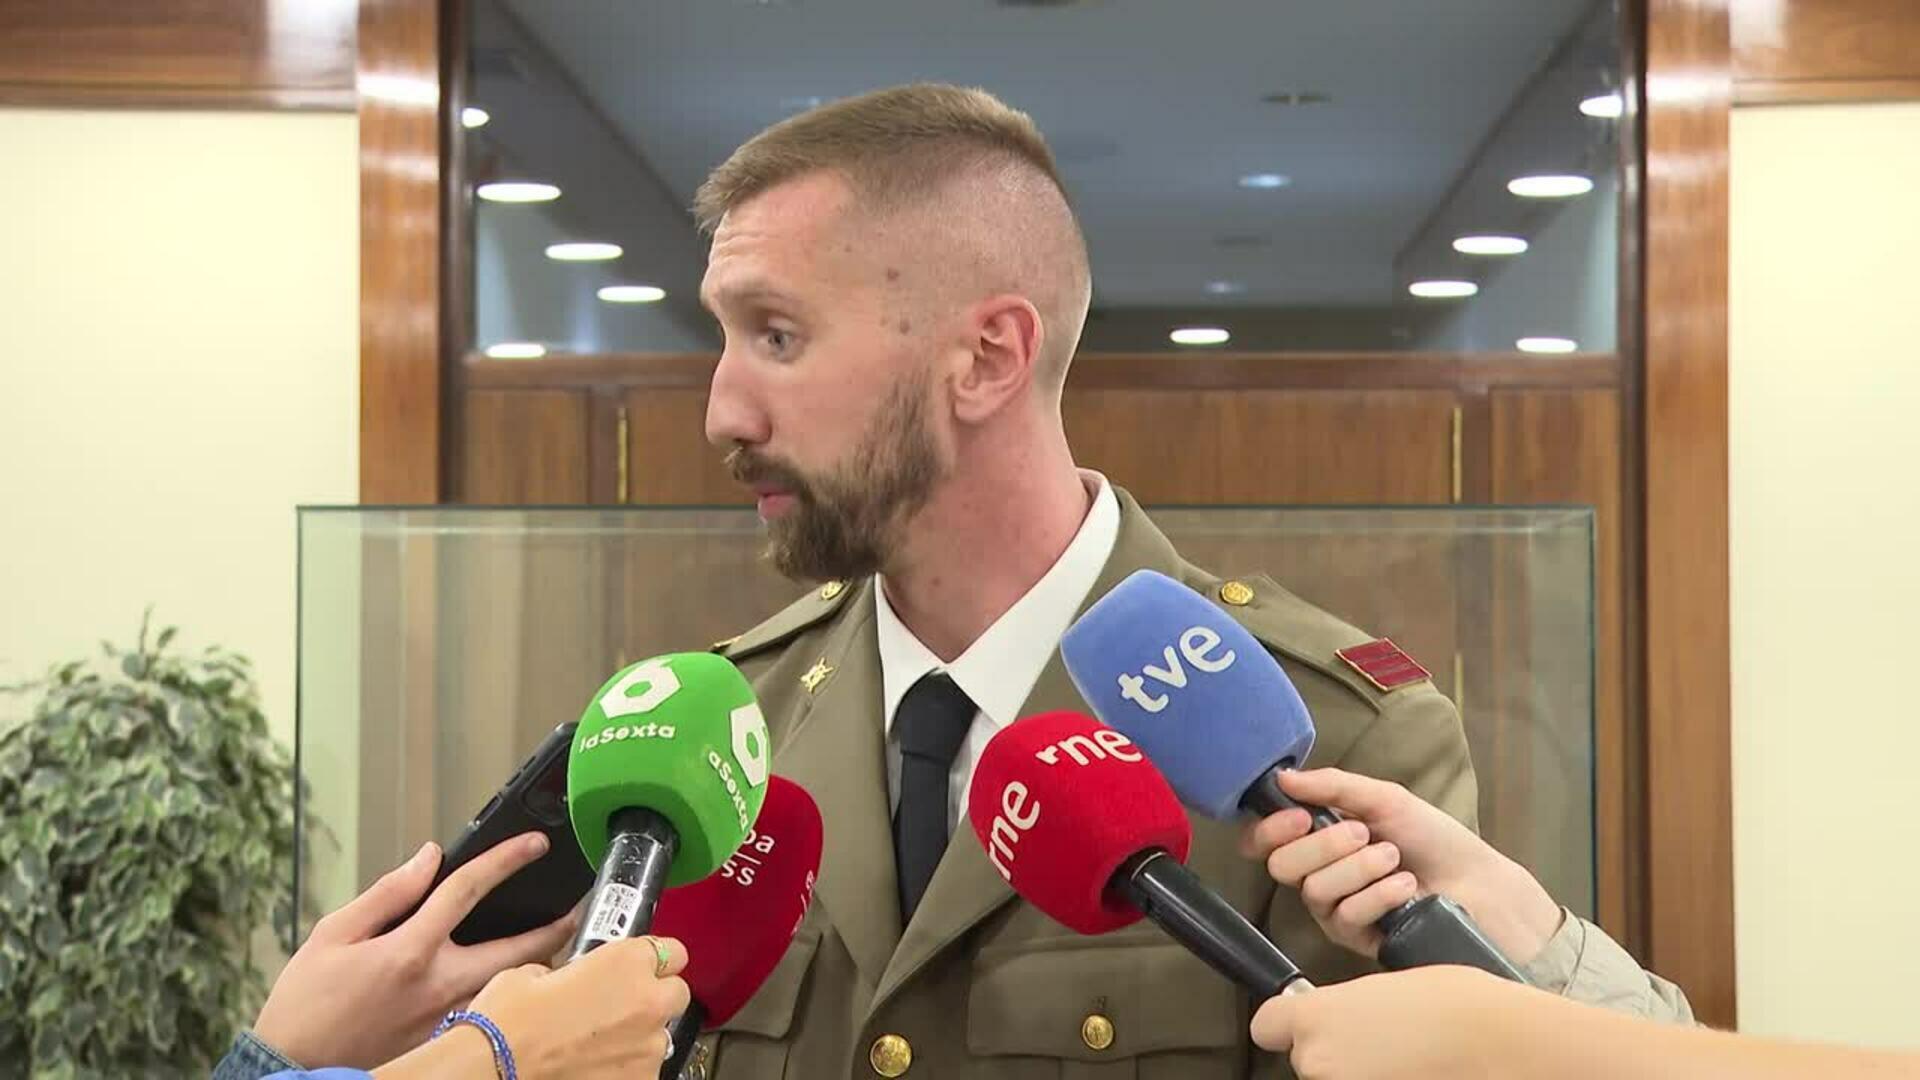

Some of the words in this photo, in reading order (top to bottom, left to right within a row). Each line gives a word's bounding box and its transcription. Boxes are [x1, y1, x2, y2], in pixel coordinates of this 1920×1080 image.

[1118, 626, 1236, 713] tve
[579, 722, 676, 753] laSexta
[1035, 730, 1143, 766] rne
[989, 781, 1040, 881] rne
